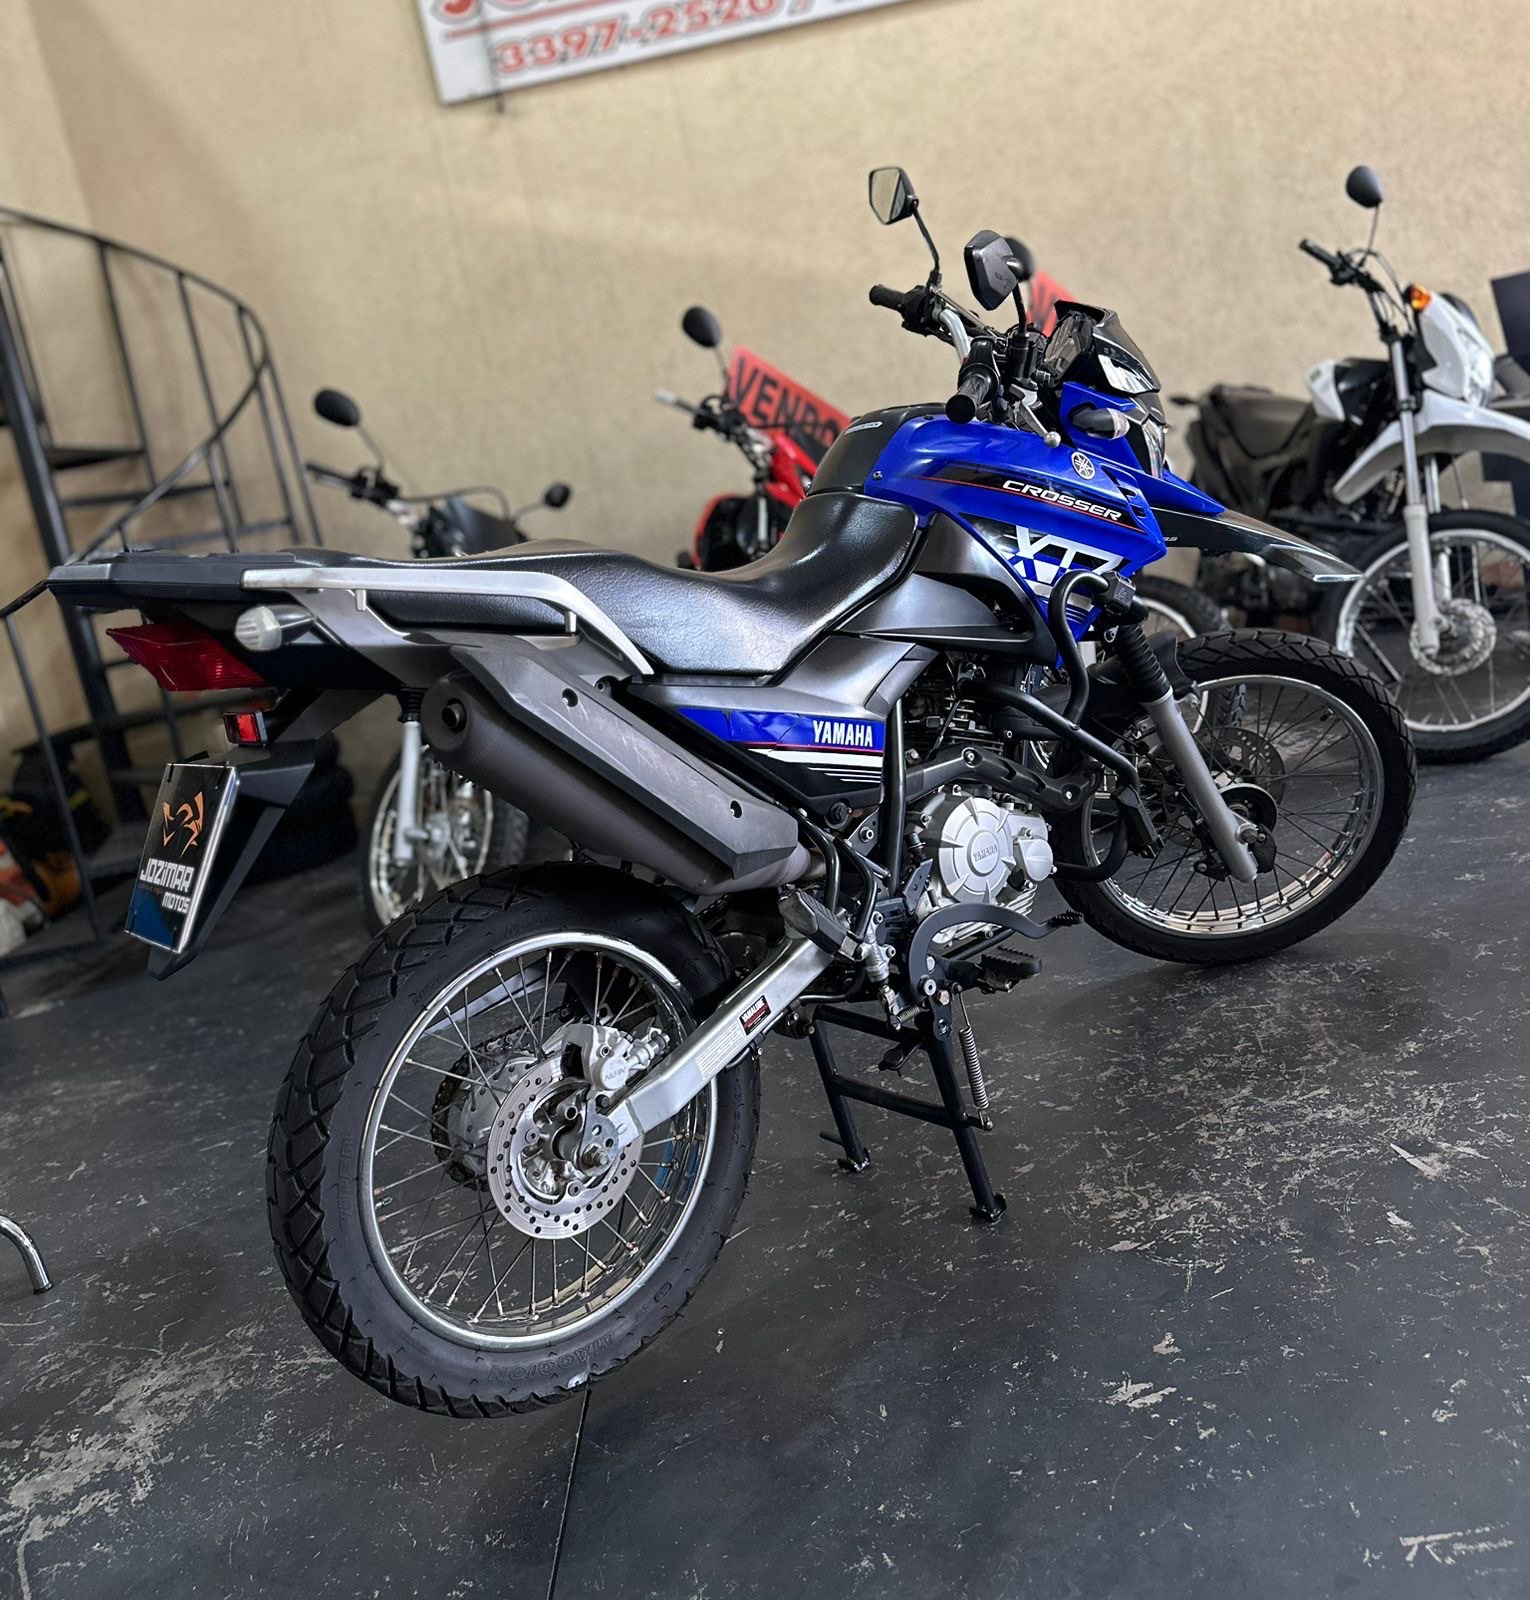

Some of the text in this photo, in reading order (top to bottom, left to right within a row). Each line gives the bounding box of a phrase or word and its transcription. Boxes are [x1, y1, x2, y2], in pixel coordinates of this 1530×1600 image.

[1002, 479, 1122, 521] CROSSER
[812, 719, 873, 747] YAMAHA
[162, 892, 191, 914] MOTOS
